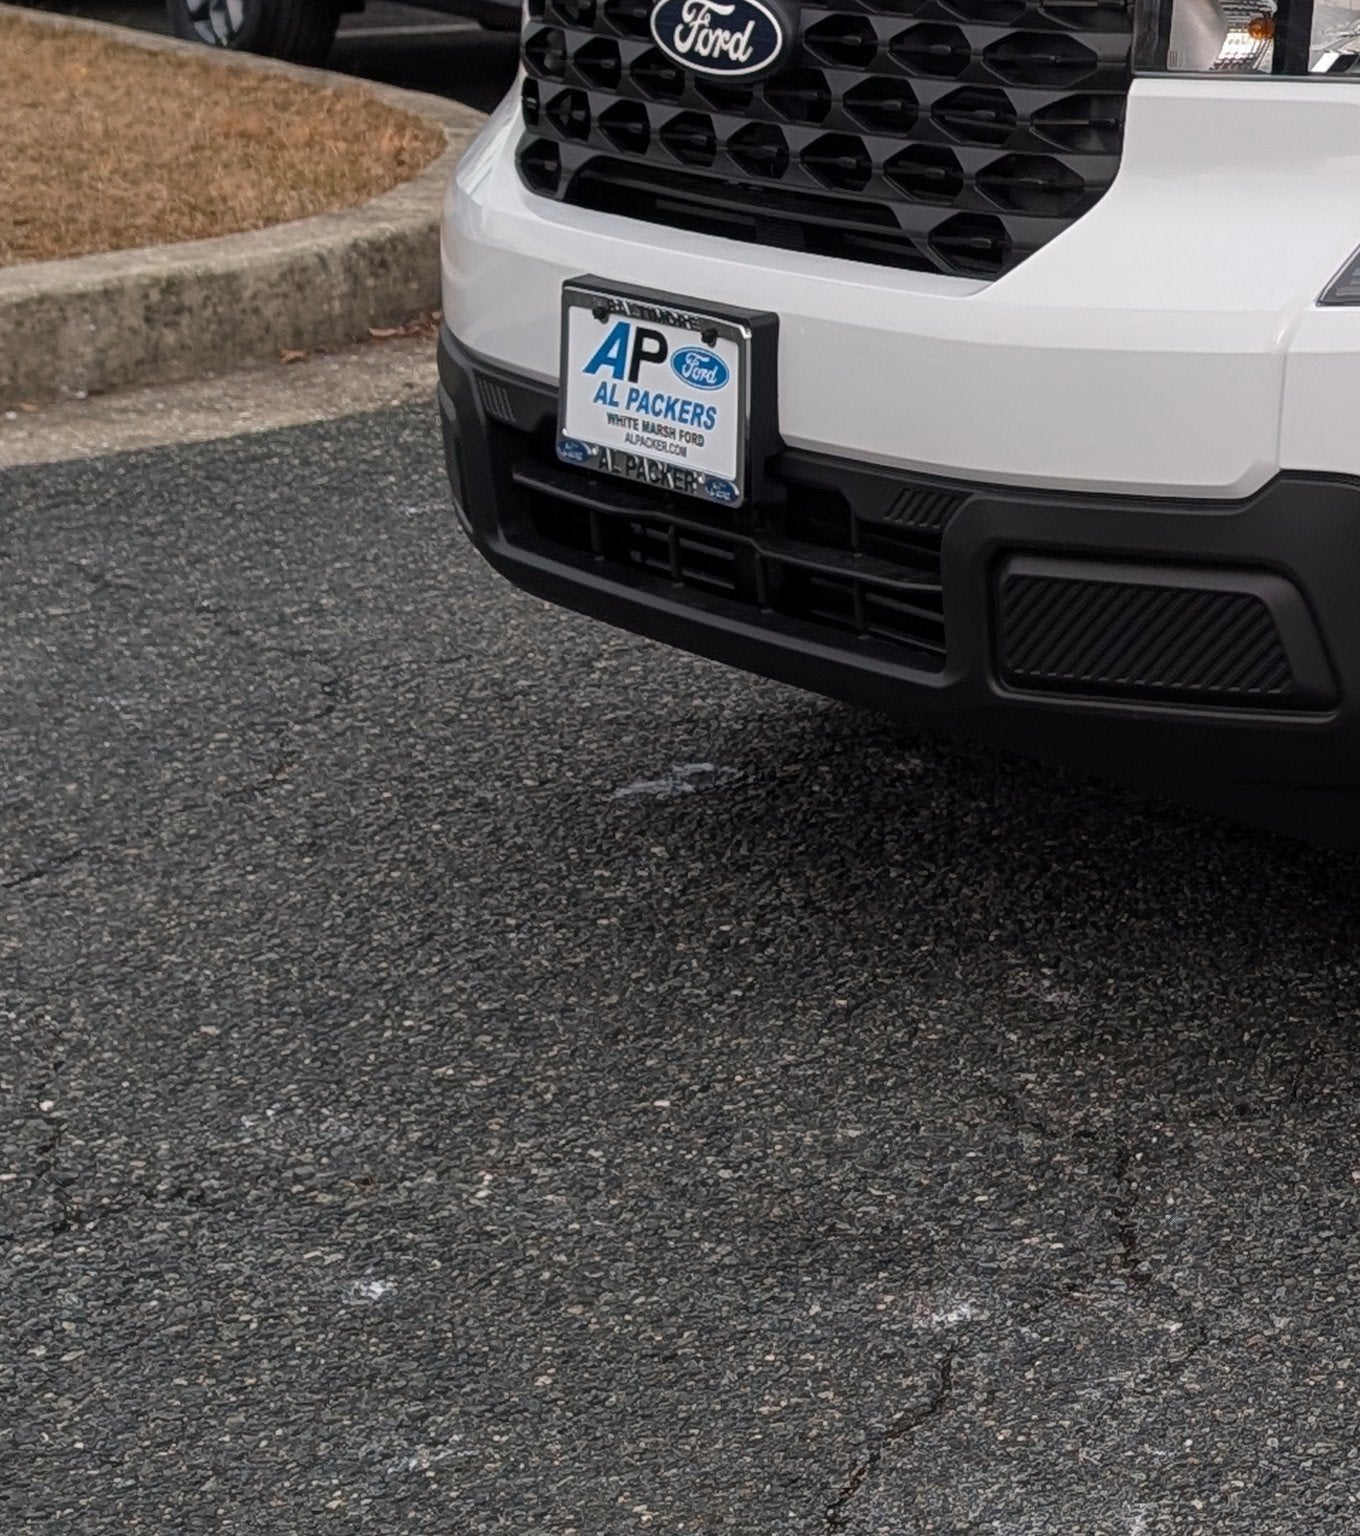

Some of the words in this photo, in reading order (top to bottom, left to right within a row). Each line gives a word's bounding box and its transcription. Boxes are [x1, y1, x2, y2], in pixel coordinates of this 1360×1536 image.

[582, 321, 668, 384] AP
[681, 352, 718, 384] Ford
[593, 381, 619, 407] AL
[625, 387, 718, 431] PACKERS
[607, 413, 640, 431] WHITE
[641, 419, 677, 441] MARSH
[678, 427, 705, 448] FORD
[624, 432, 688, 458] ALPACKER.COM
[598, 450, 621, 474] AL
